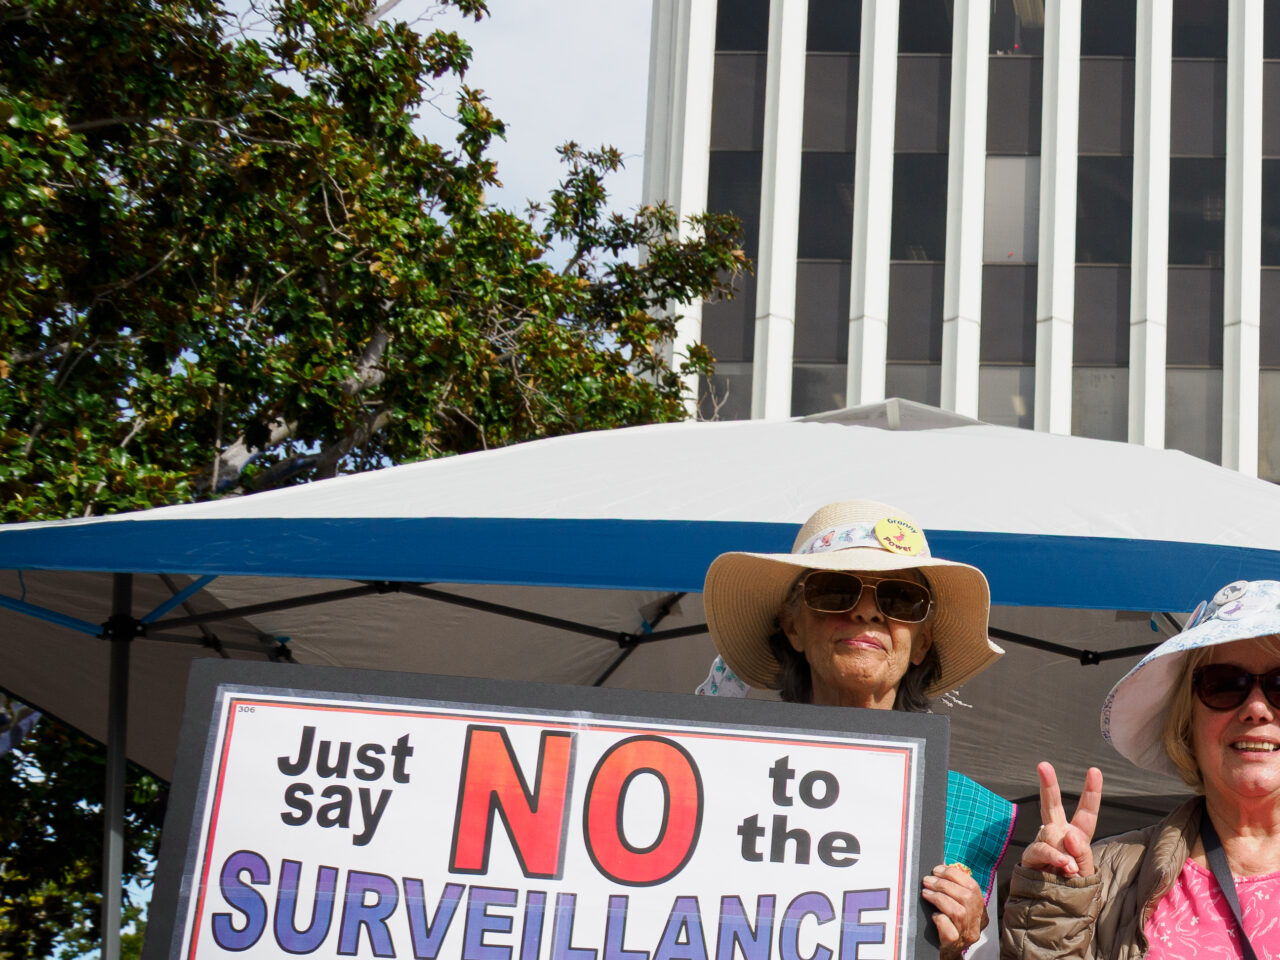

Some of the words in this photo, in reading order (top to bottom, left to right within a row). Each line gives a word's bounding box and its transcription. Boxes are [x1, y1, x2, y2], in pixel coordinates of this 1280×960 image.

[238, 705, 256, 713] 306
[277, 725, 414, 784] Just
[768, 755, 840, 809] to
[280, 782, 393, 847] say
[447, 723, 705, 888] NO
[737, 814, 861, 868] the
